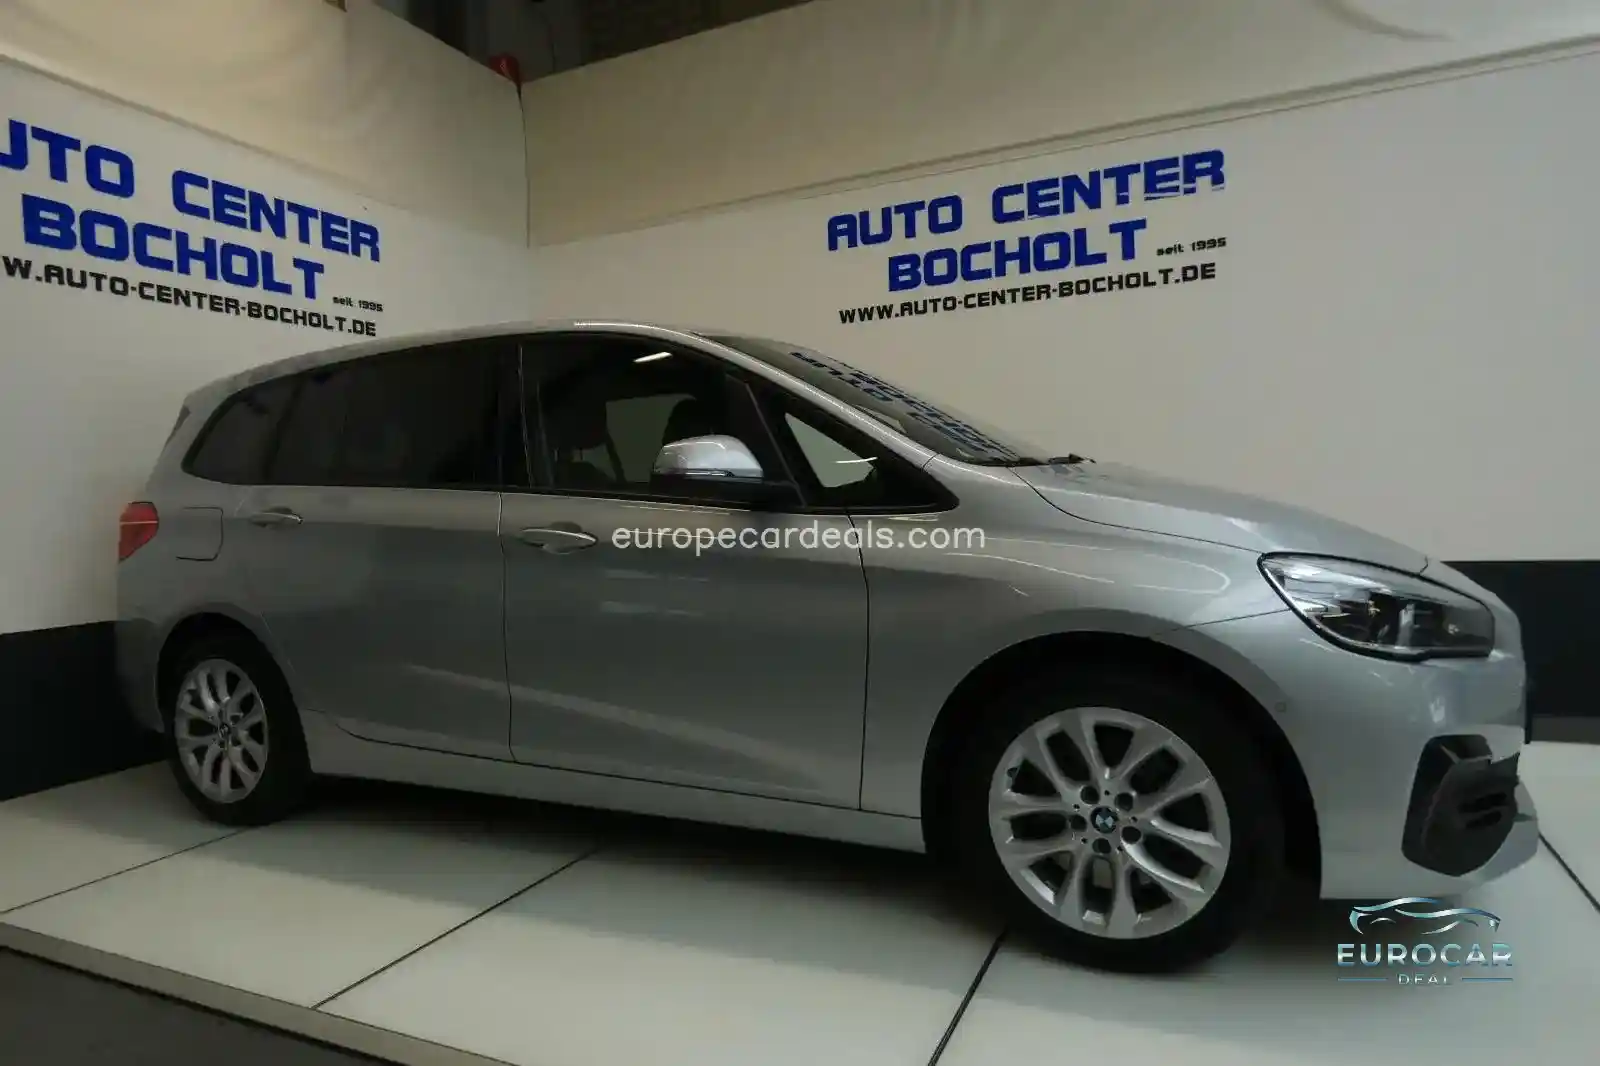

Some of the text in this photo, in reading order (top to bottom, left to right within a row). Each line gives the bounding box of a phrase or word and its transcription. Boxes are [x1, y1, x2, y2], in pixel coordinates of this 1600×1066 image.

[172, 170, 380, 262] CENTER
[828, 149, 1225, 251] AUTO CENTER
[22, 194, 324, 300] BOCHOLT
[888, 218, 1147, 292] BOCHOLT
[1191, 237, 1227, 252] 1995
[838, 262, 1216, 325] WWW.AUTO-CENTER-BOCHOLT.DE
